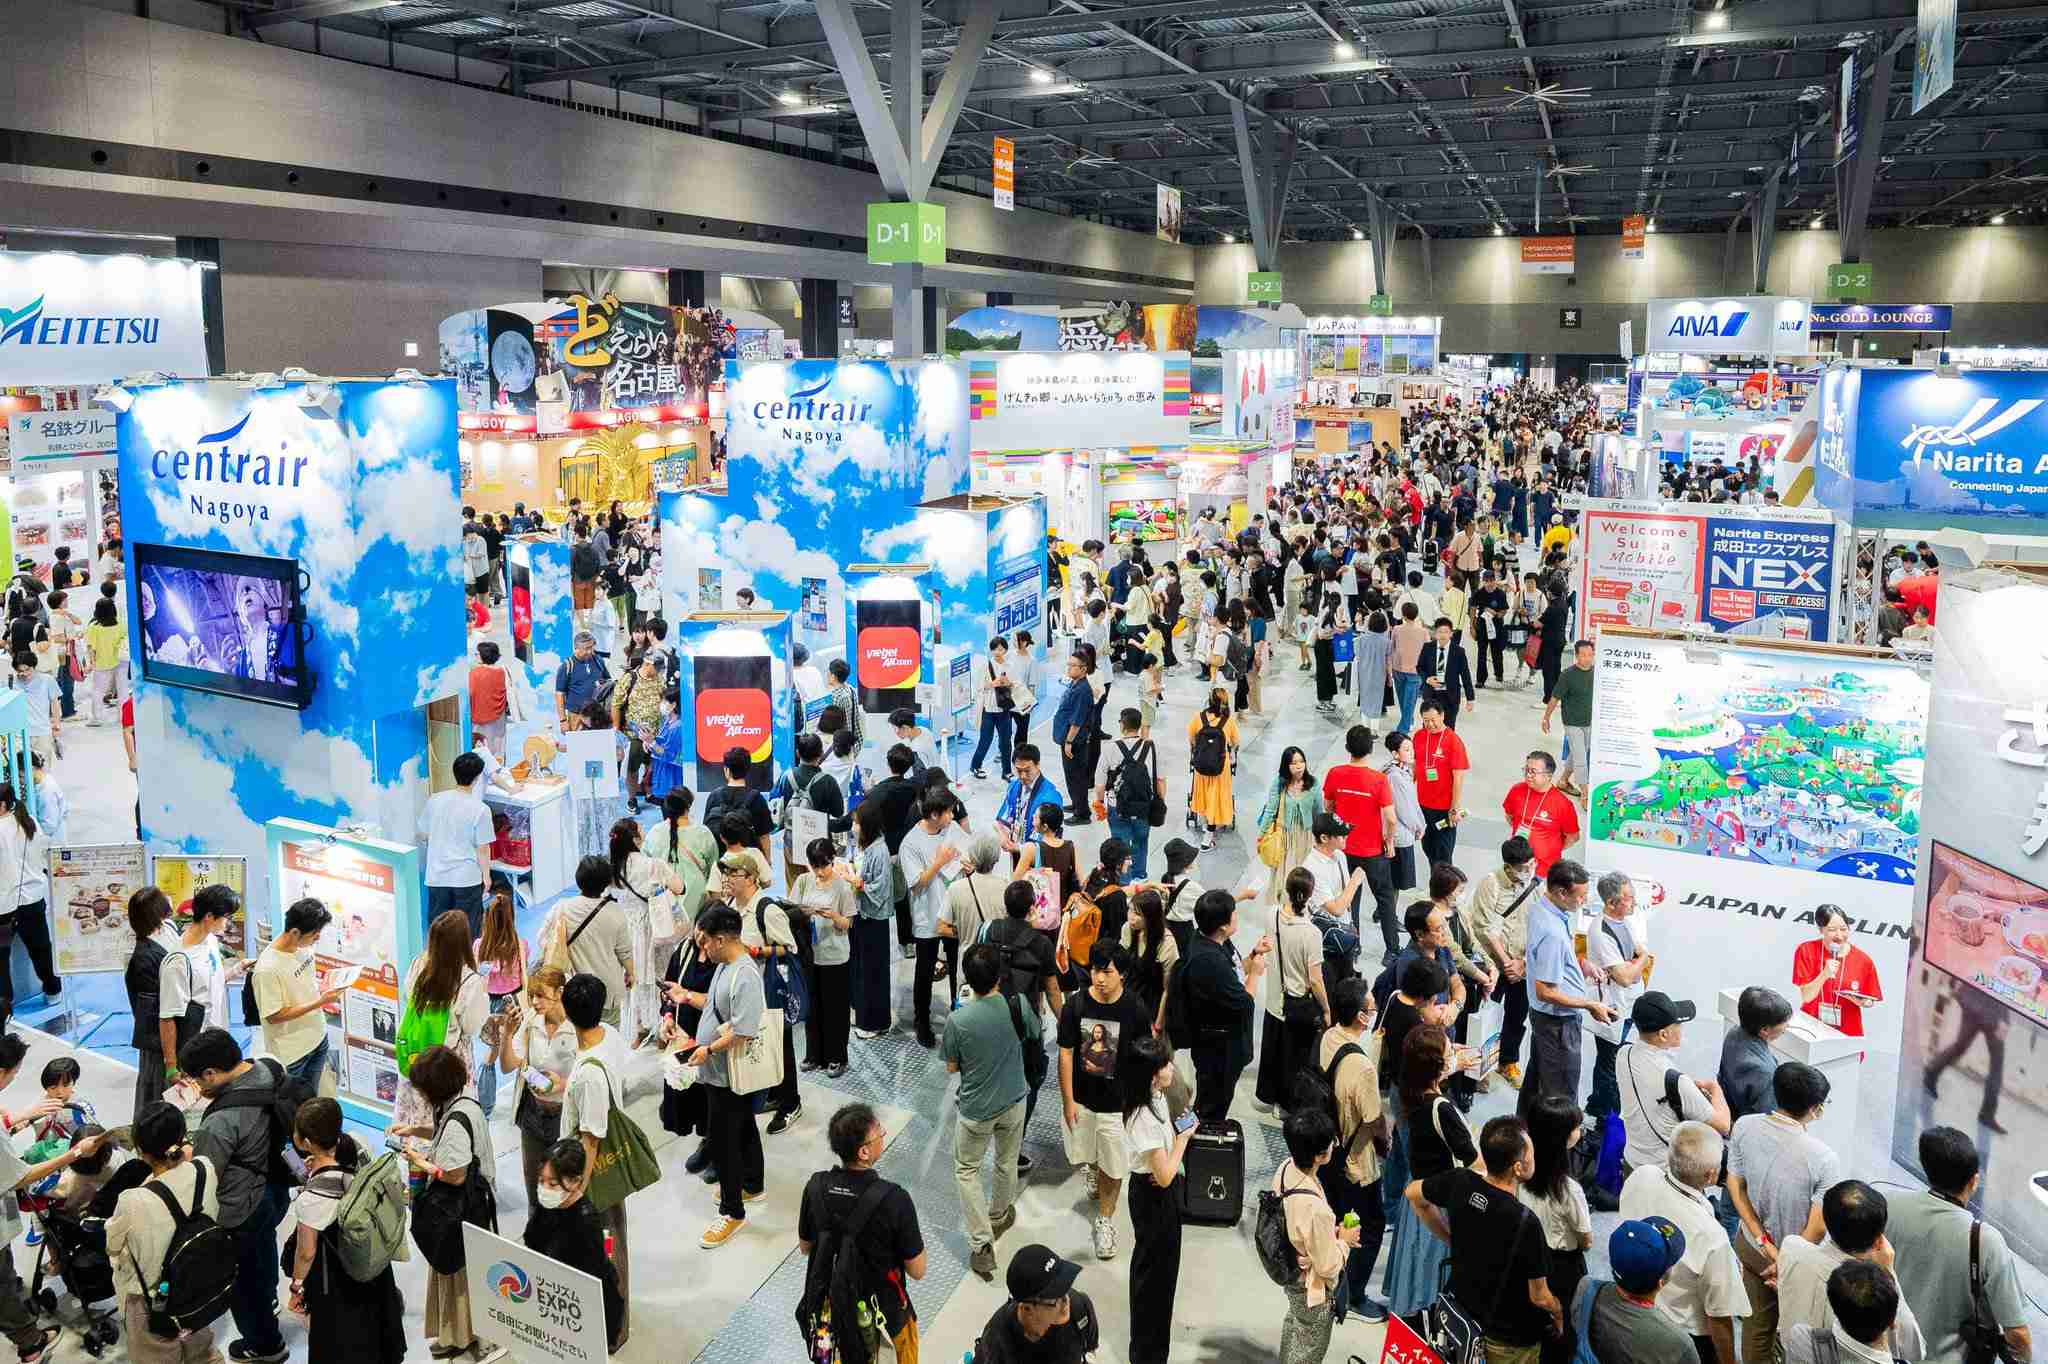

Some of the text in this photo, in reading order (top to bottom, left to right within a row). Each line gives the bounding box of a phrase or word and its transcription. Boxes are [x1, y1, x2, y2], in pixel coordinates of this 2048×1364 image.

[1836, 274, 1867, 288] D-2
[1316, 319, 1358, 331] JAPAN
[1667, 314, 1721, 337] ANA
[1872, 312, 1933, 324] LOUNGE
[753, 396, 873, 422] centrair
[782, 427, 843, 445] Nagoya
[152, 440, 308, 487] centrair
[1932, 450, 2023, 474] Narita
[1949, 480, 2014, 494] Connecting
[190, 494, 270, 526] Nagoya
[1600, 520, 1688, 538] Welcome
[1713, 527, 1830, 543] Narita Express
[1609, 551, 1677, 566] Mobile
[1712, 539, 1829, 559] 成田エクスプレス
[1760, 593, 1789, 604] DIRECT
[1680, 892, 1787, 919] JAPAN
[537, 1287, 582, 1320] EXPO
[539, 1305, 583, 1333] ジャパン
